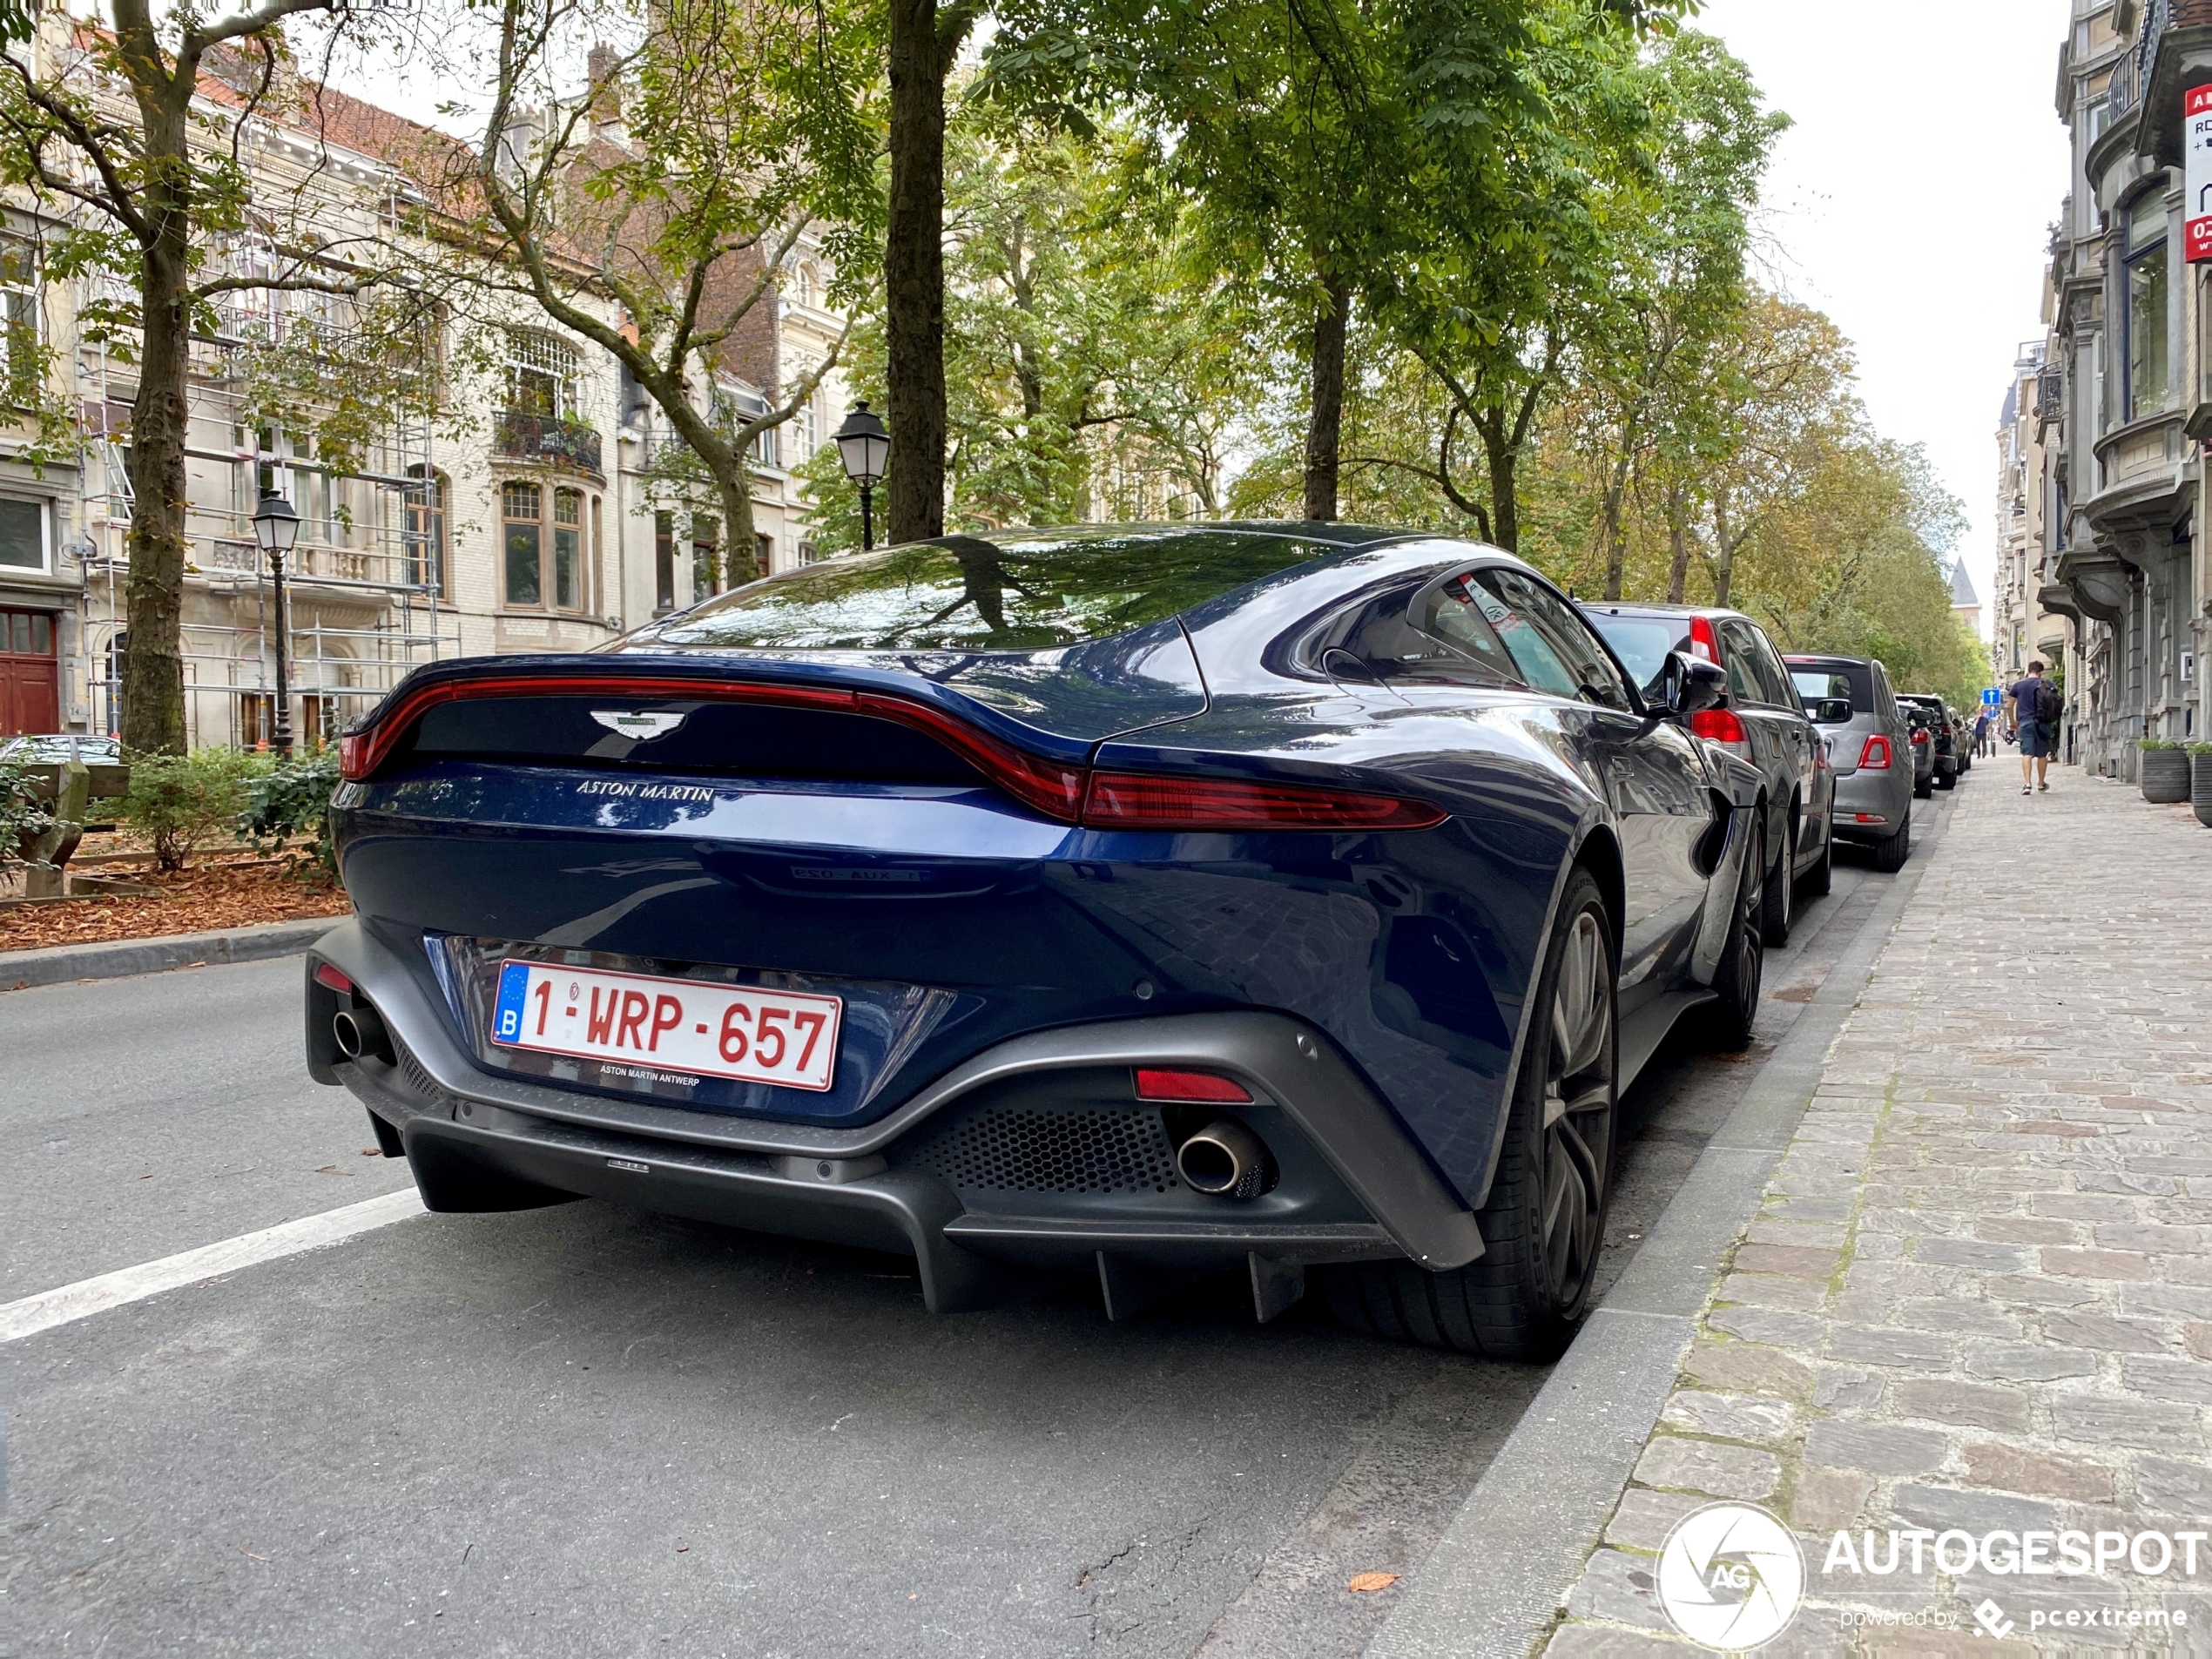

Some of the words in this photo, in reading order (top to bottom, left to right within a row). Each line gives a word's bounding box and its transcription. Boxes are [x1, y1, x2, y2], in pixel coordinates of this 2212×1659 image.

[577, 780, 637, 797] ASTON
[639, 785, 714, 802] MARTIN
[501, 1009, 518, 1036] B
[600, 1064, 627, 1076] ASTON
[628, 1069, 658, 1082] MARTIN
[659, 1073, 700, 1087] ANTWERP
